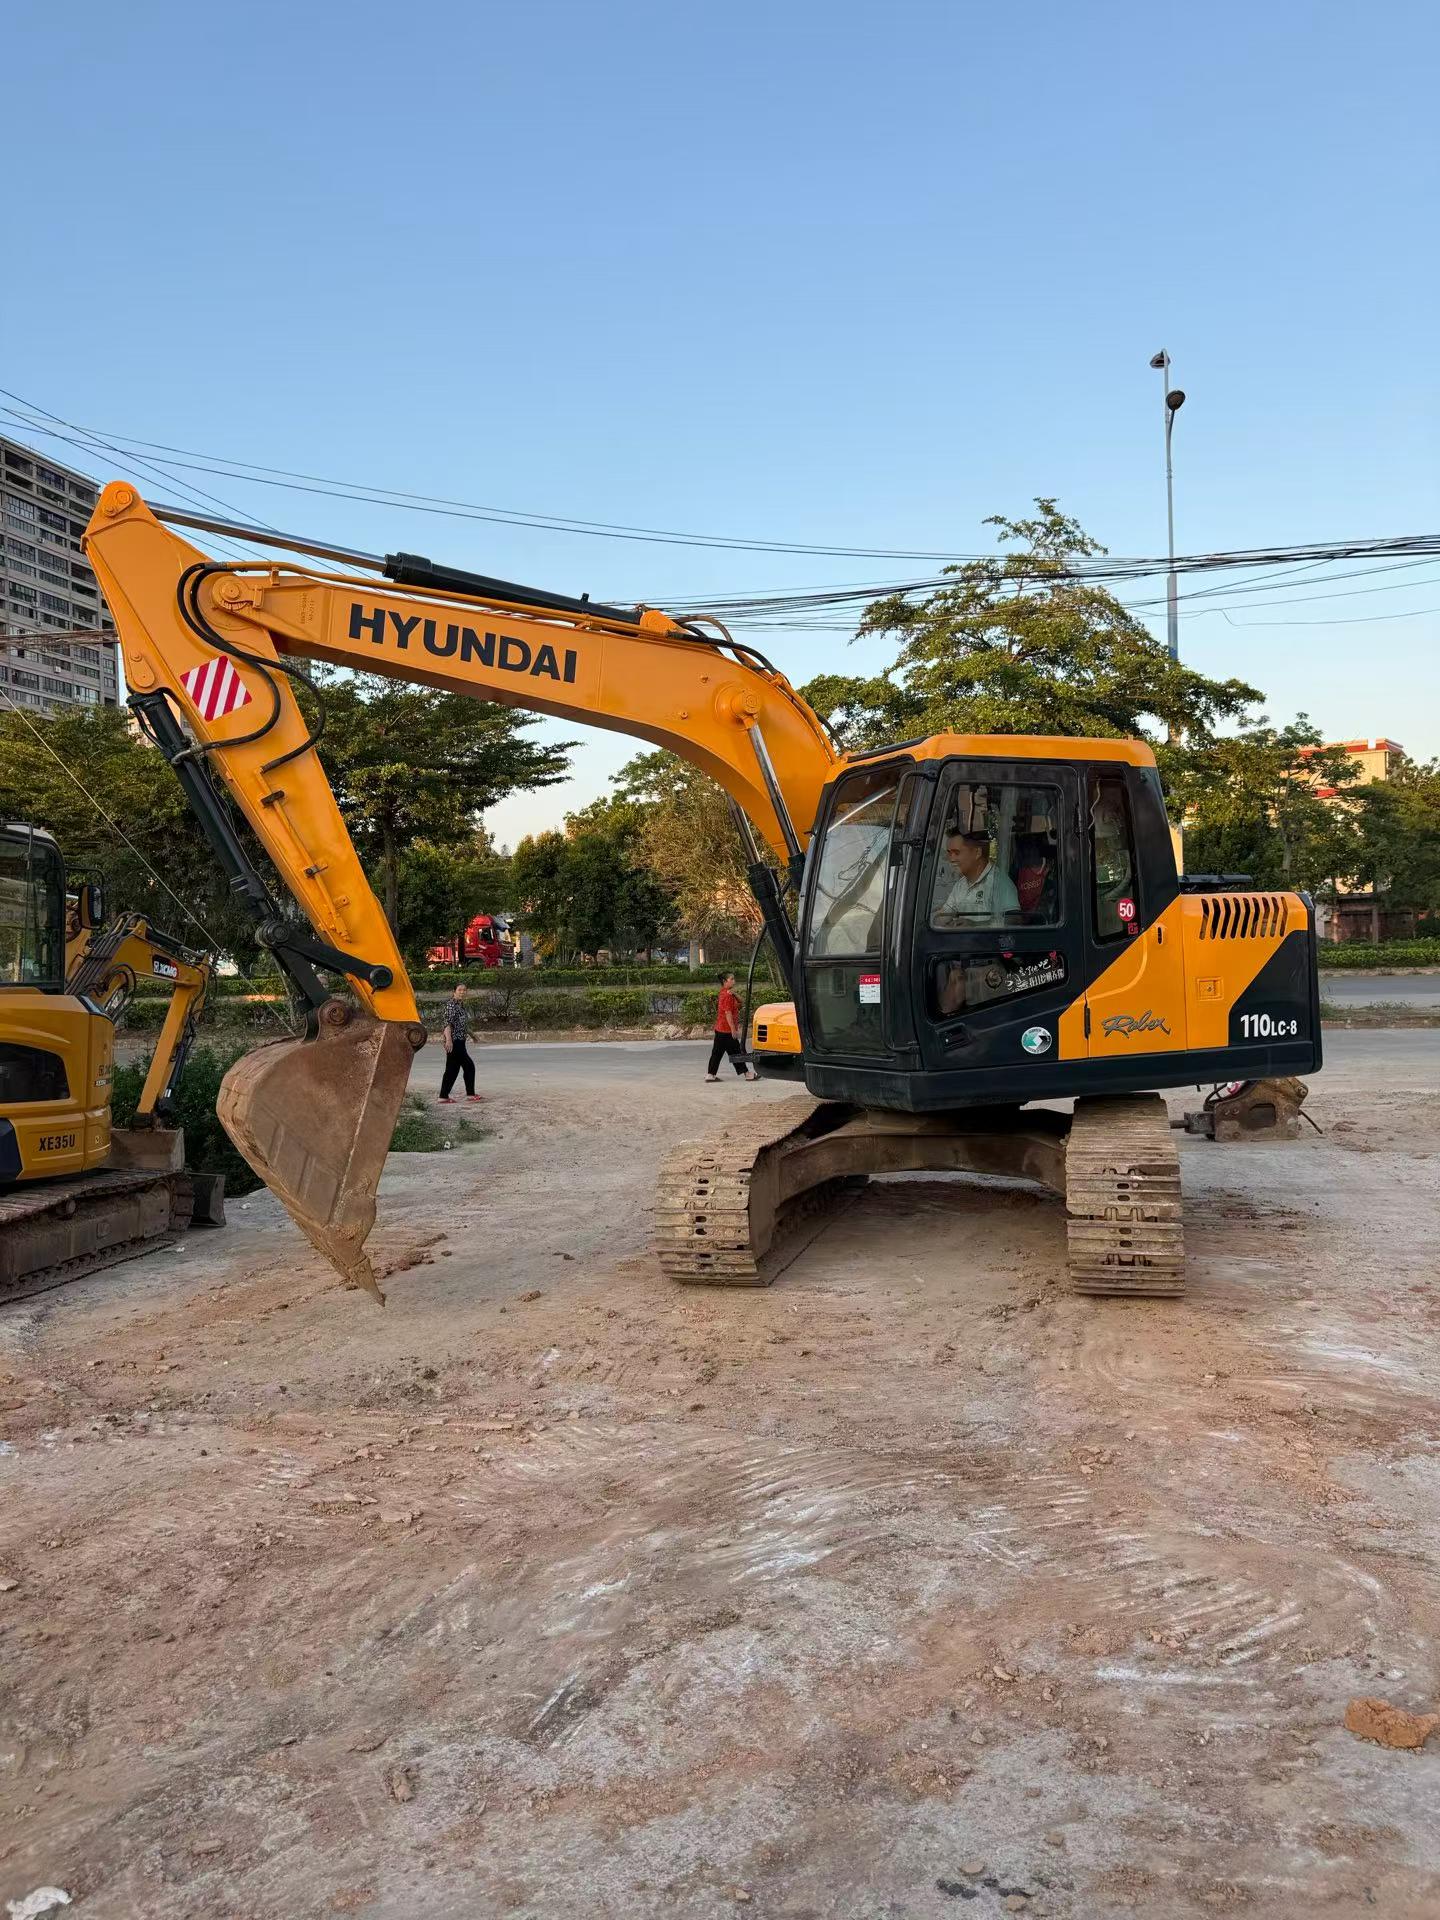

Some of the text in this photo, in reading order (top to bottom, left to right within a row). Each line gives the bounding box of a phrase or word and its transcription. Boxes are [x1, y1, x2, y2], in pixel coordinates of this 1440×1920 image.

[348, 603, 578, 684] HYUNDAI
[1119, 902, 1133, 918] 50
[159, 962, 178, 978] XCMG
[39, 1134, 76, 1152] XE35U
